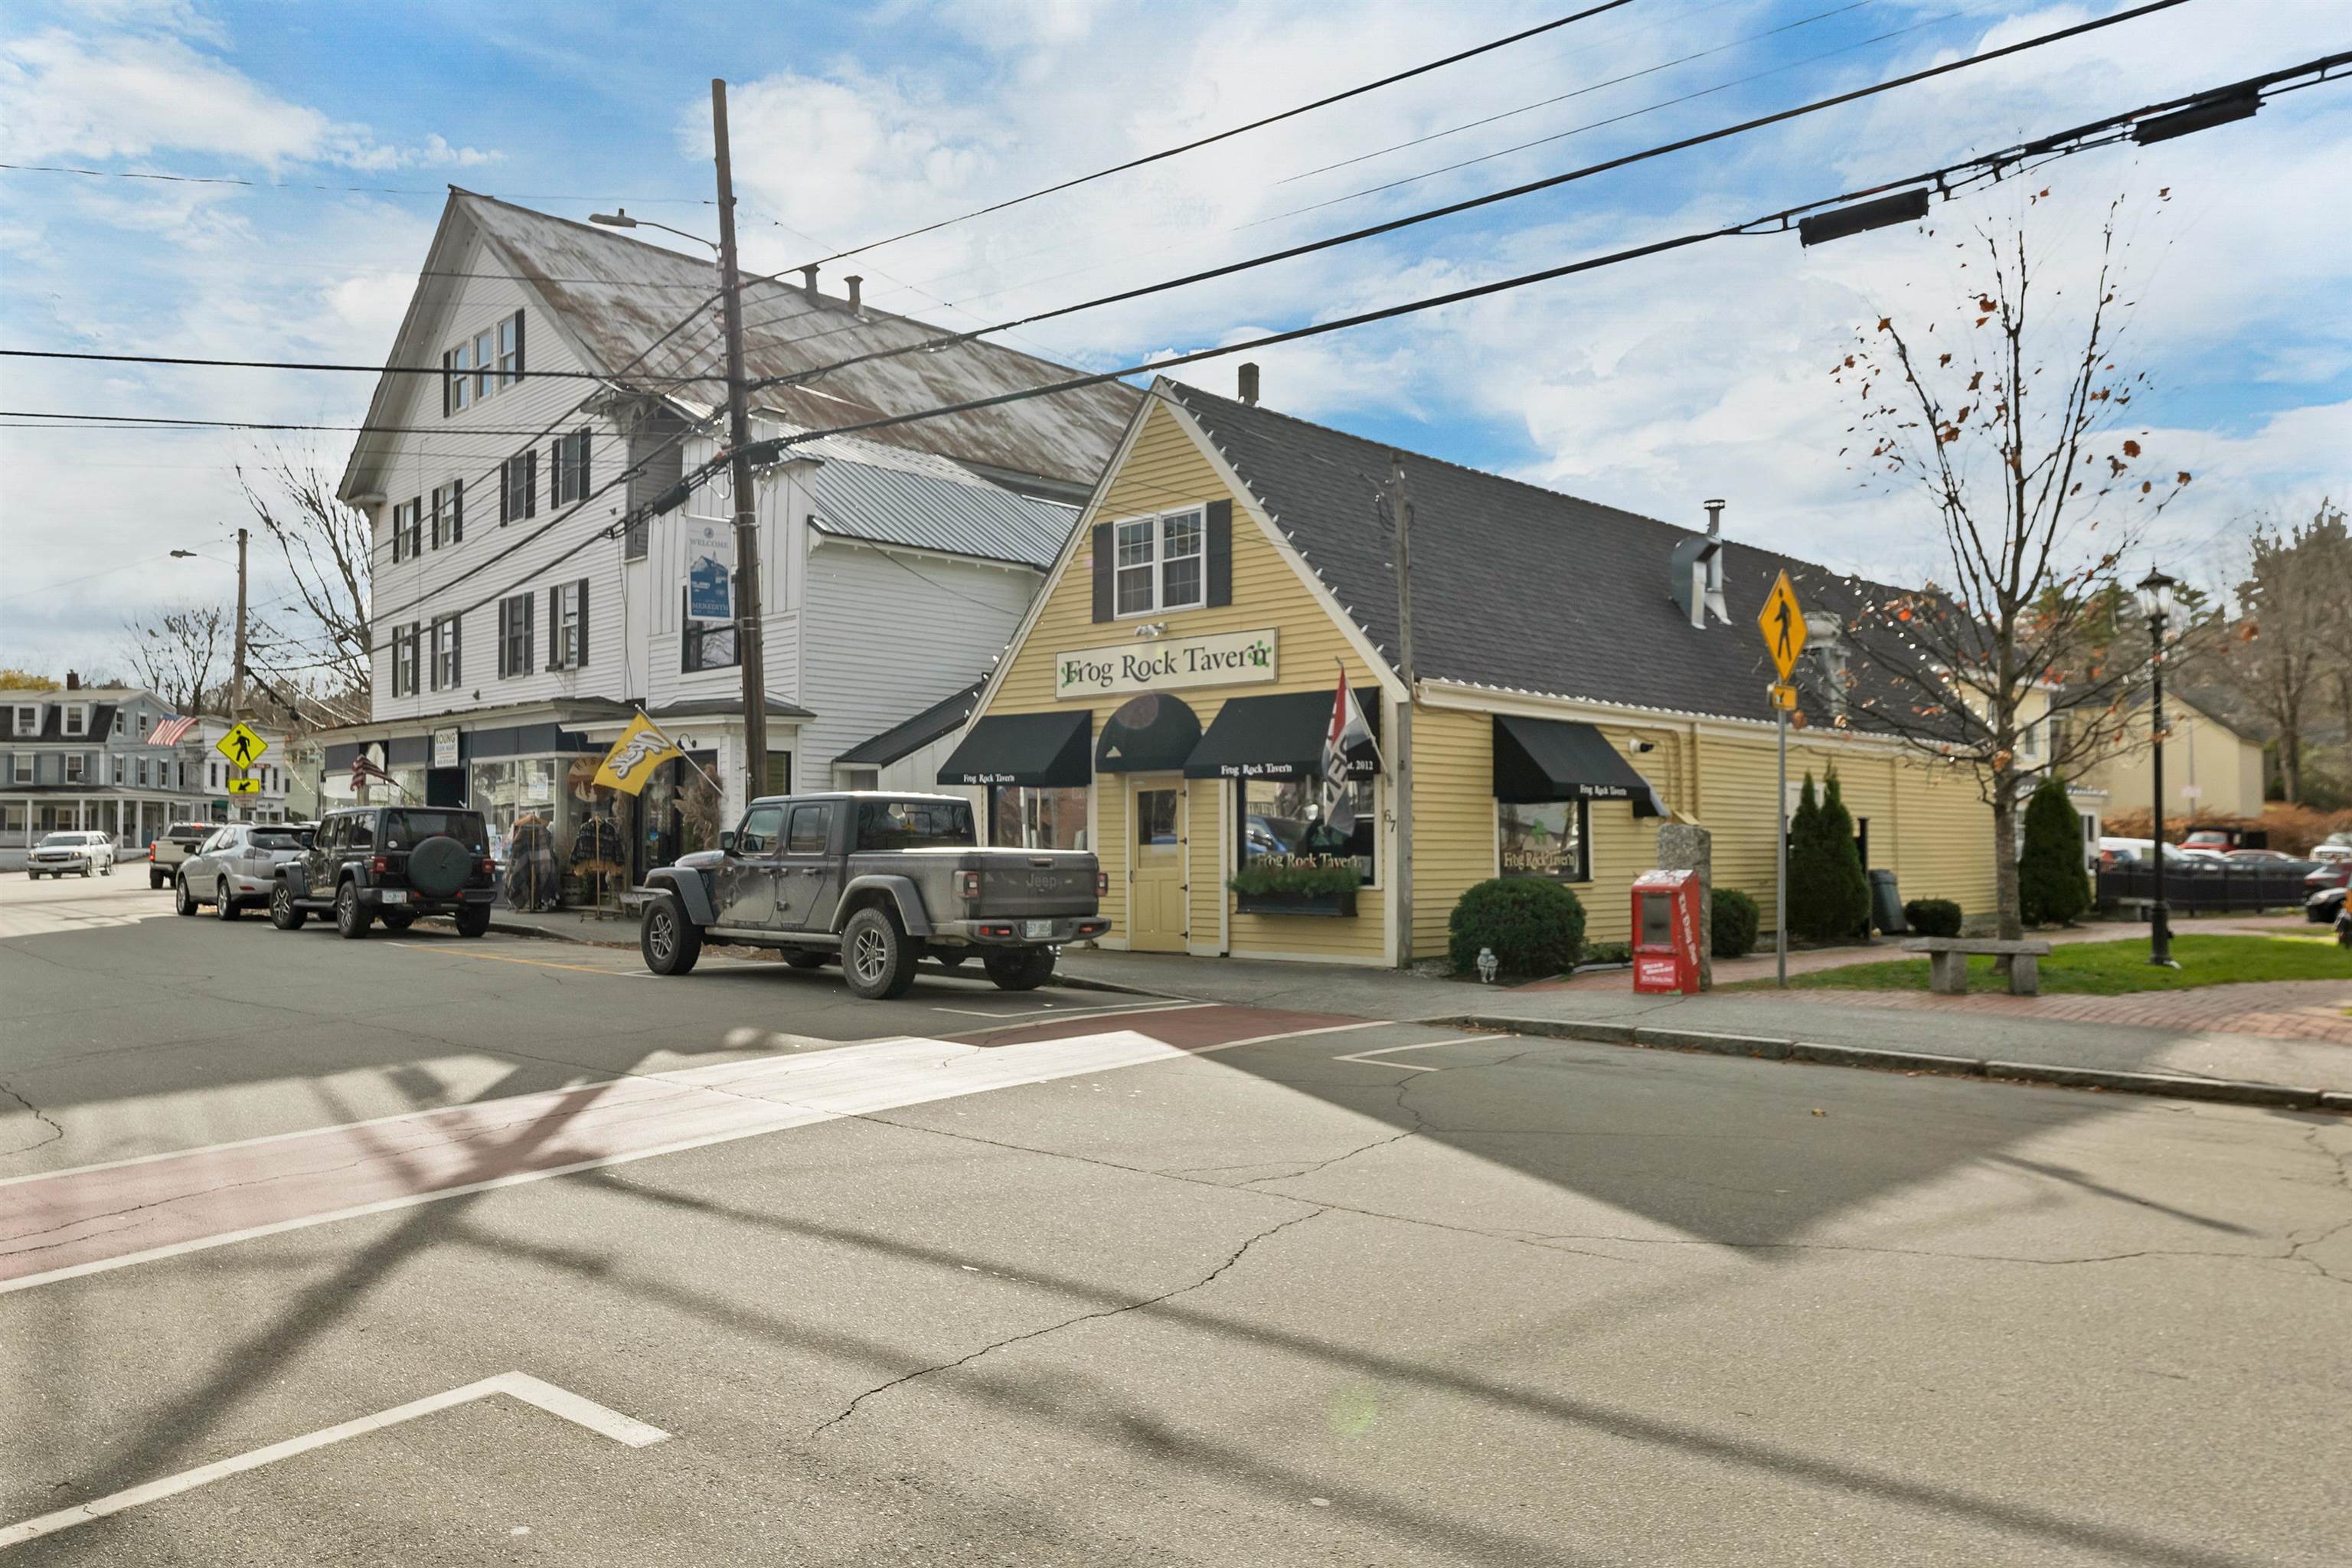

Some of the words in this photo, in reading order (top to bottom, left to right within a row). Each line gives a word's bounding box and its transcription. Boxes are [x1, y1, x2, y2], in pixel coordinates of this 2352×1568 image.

[1065, 660, 1114, 688] Frog
[1121, 650, 1178, 682] Rock
[1183, 645, 1267, 672] Tavern
[1221, 765, 1240, 776] Frog
[1243, 764, 1263, 776] Rock
[1265, 763, 1292, 773] Tavern
[1356, 760, 1374, 770] 2012
[963, 774, 977, 784] Frog
[979, 773, 994, 783] Rock
[995, 773, 1015, 782] Tavern
[1286, 853, 1317, 868] Rock
[1026, 874, 1057, 890] Jeep
